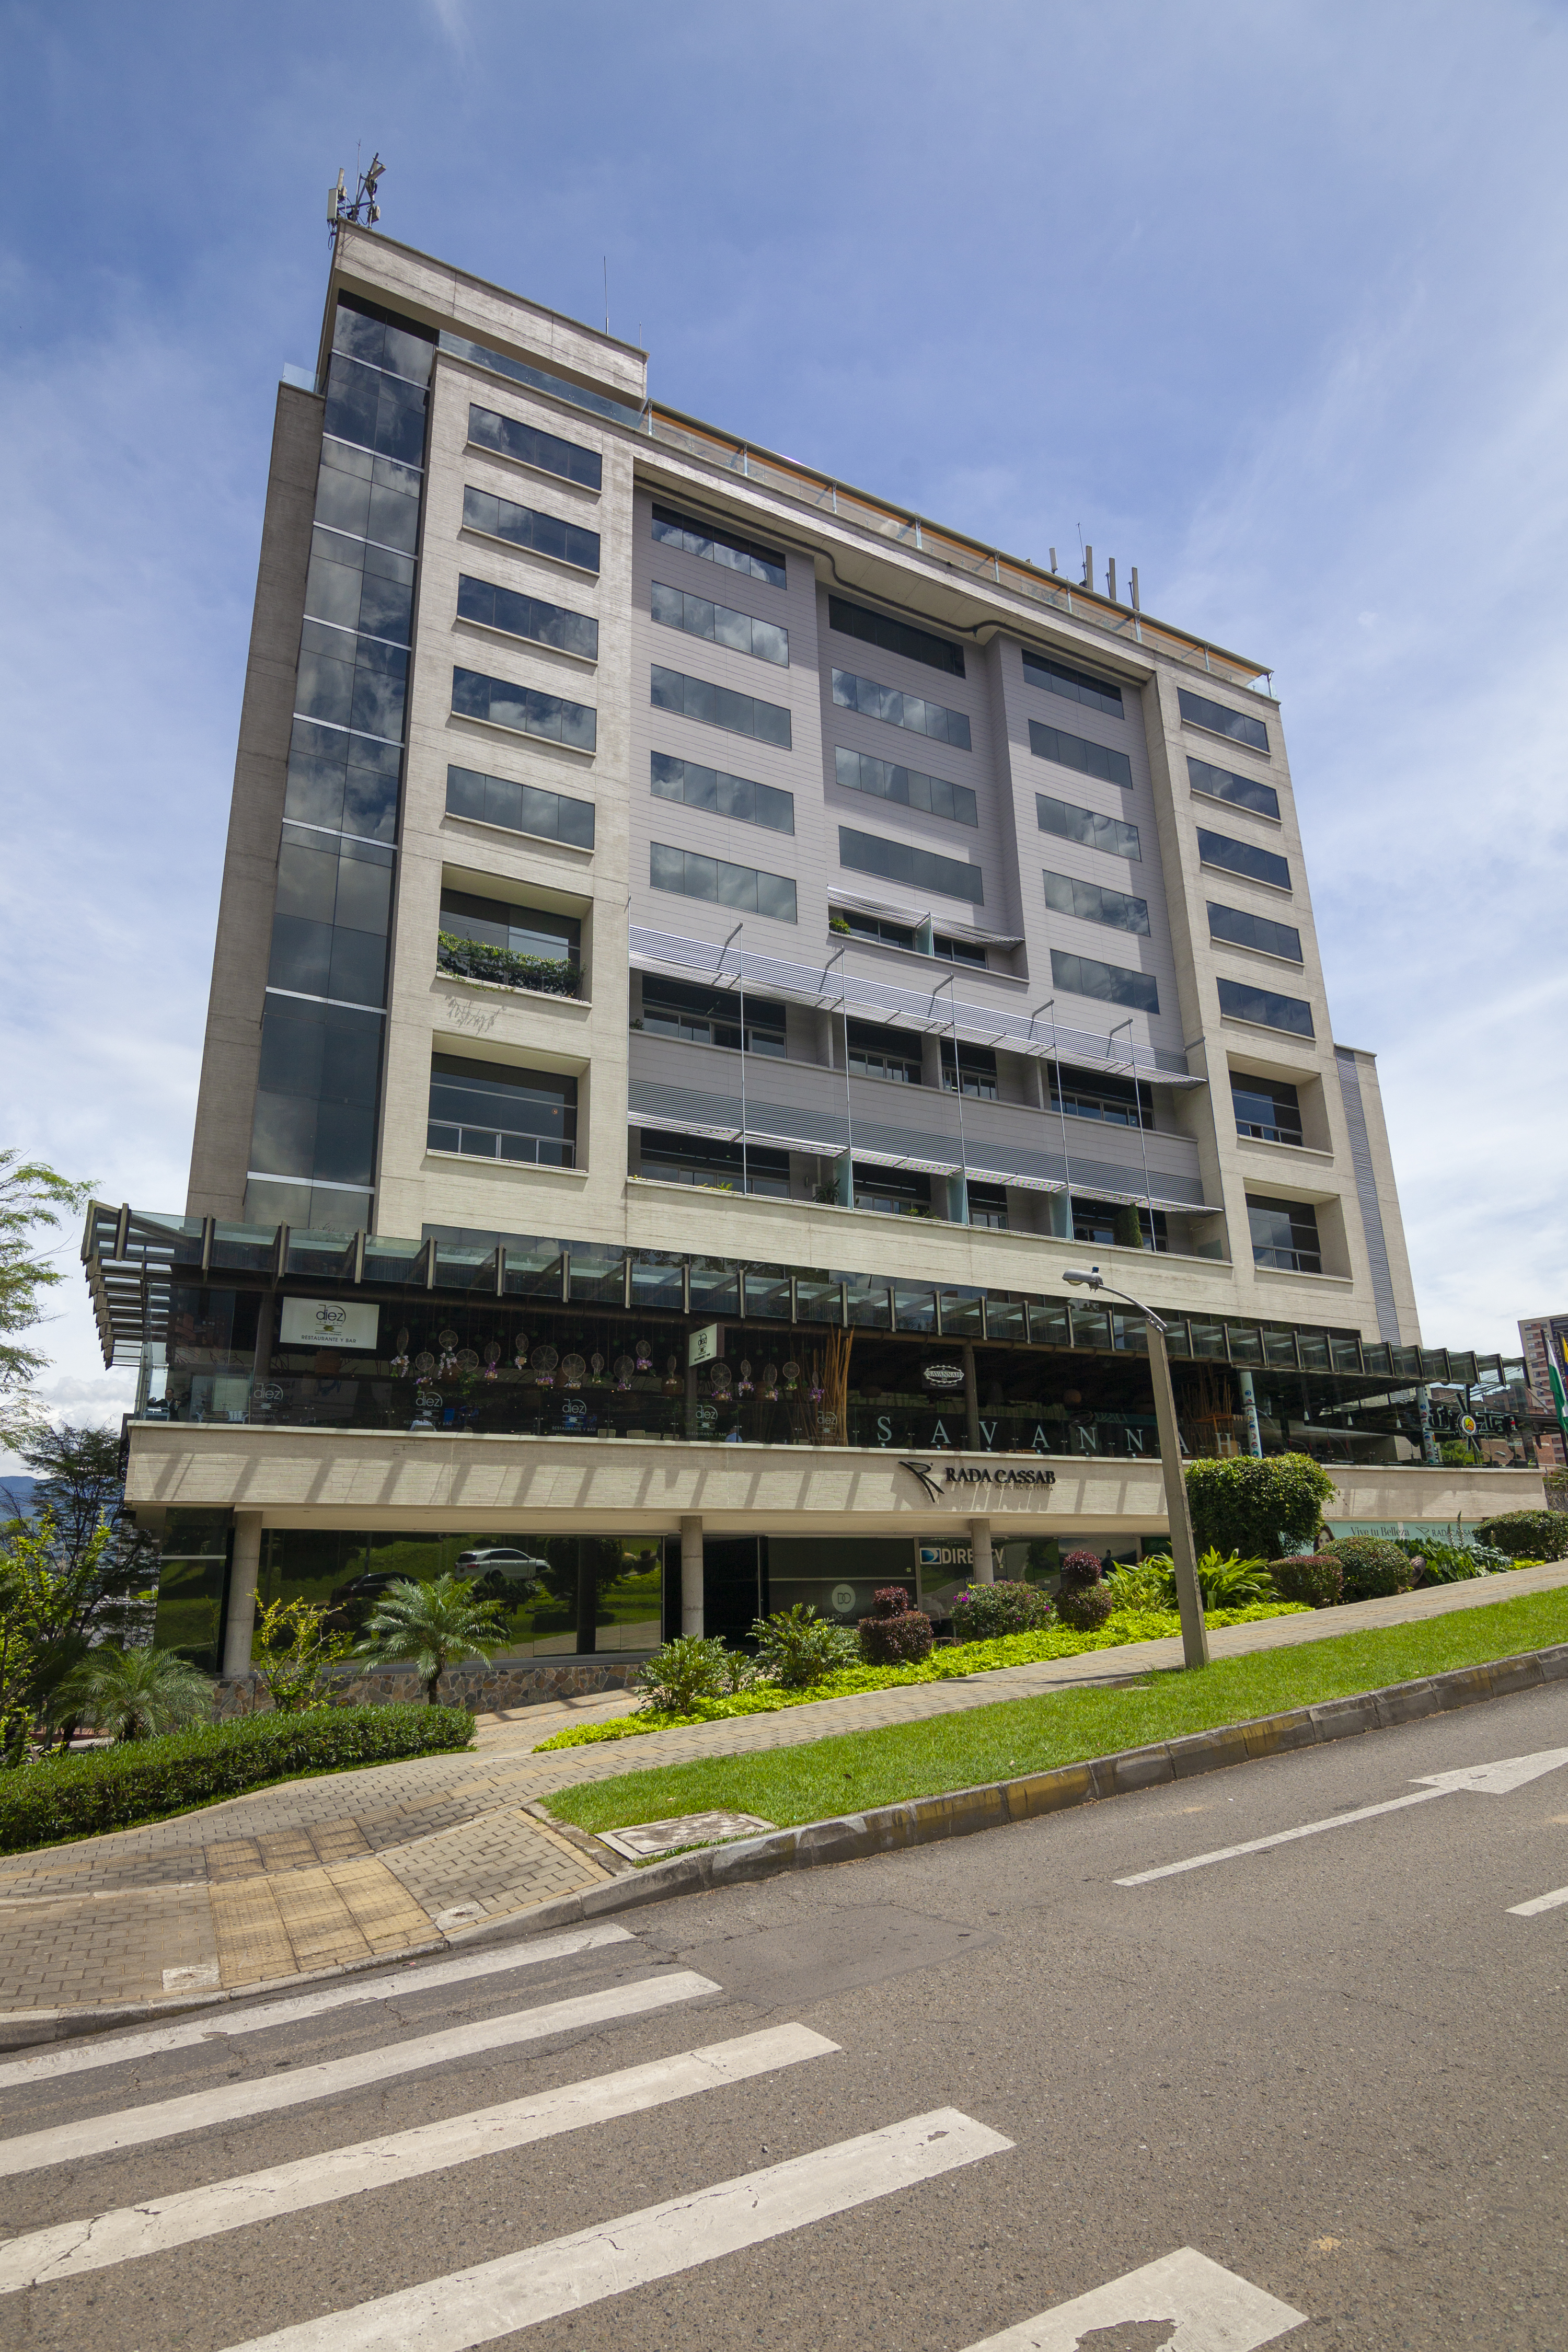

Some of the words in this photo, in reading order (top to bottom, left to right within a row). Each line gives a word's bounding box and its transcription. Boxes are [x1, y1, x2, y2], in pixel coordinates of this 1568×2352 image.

[316, 1305, 343, 1322] diez
[253, 1383, 280, 1399] diez
[416, 1391, 440, 1407] diez
[562, 1399, 584, 1413] diez
[696, 1405, 716, 1419] diez
[817, 1411, 835, 1424] diez
[945, 1468, 993, 1483] RADA
[994, 1469, 1056, 1484] CASSAB
[1351, 1527, 1369, 1536] Vive
[1370, 1527, 1379, 1536] tu
[1380, 1527, 1410, 1536] Belleza
[942, 1548, 1004, 1564] DIREV
